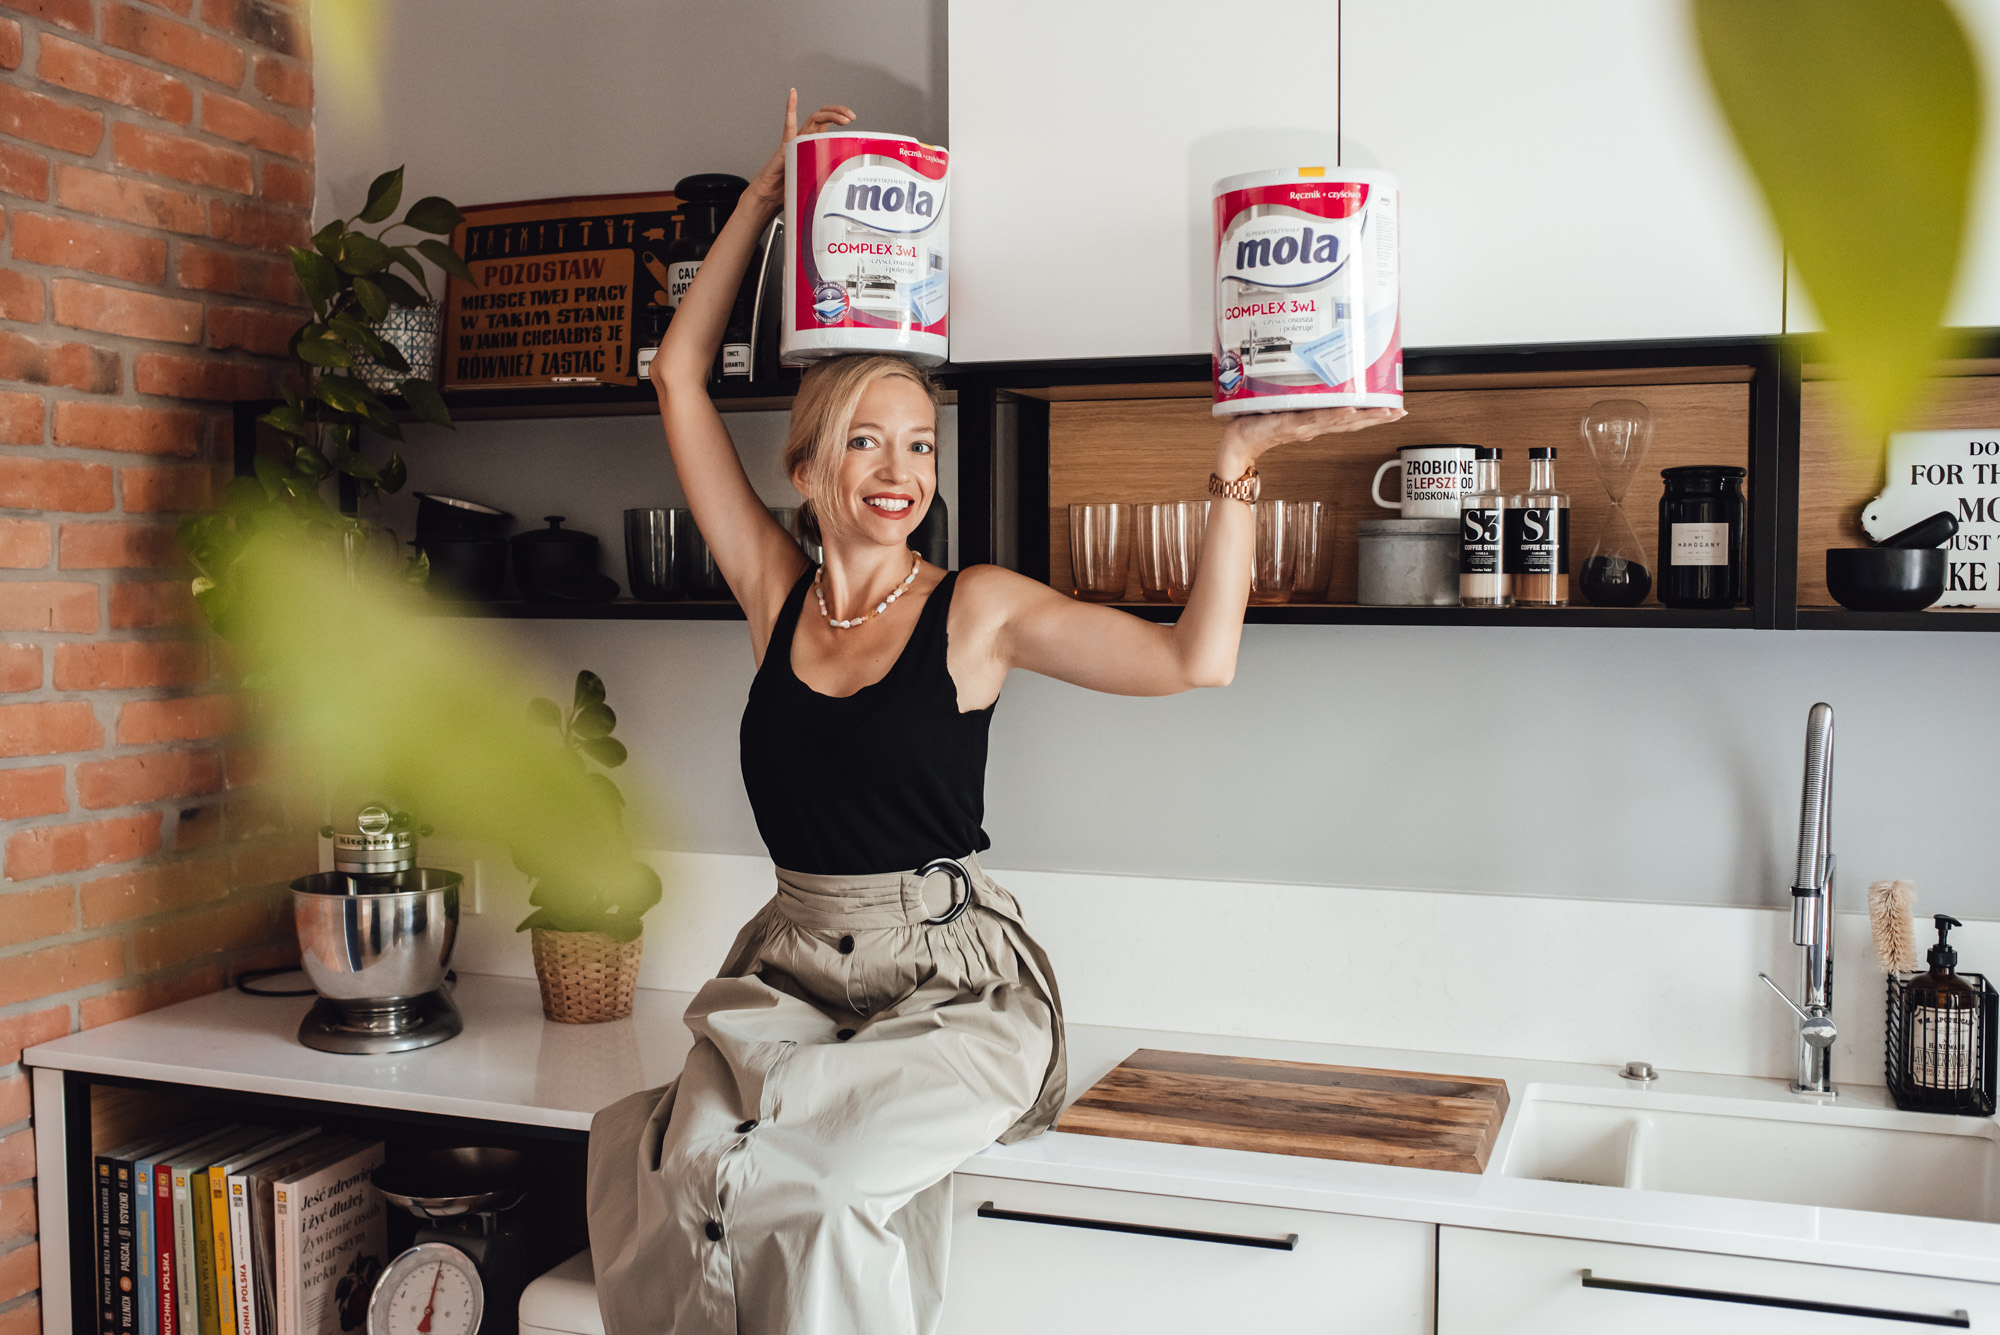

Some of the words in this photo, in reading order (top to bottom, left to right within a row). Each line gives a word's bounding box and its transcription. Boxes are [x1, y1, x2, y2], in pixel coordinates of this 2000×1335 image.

[899, 148, 922, 158] Ręcznik
[845, 181, 934, 218] mola
[1290, 190, 1321, 201] Ręcznik
[828, 242, 892, 256] COMPLEX
[896, 246, 917, 258] 3w1
[1236, 227, 1339, 270] mola
[484, 257, 606, 288] POZOSTAW
[461, 290, 527, 312] MIEJSCE
[529, 290, 568, 306] TWEJ
[574, 284, 628, 303] PRACY
[826, 291, 832, 300] 3
[460, 314, 480, 329] W
[485, 308, 550, 329] TAKIM
[556, 304, 626, 324] STANIE
[1225, 302, 1286, 320] COMPLEX
[1290, 300, 1316, 312] 3w1
[460, 334, 474, 350] W
[475, 331, 518, 348] JAKIM
[606, 324, 624, 342] JE
[1283, 325, 1314, 334] poleruje
[457, 352, 533, 380] RÓWNIEŻ
[541, 345, 605, 376] ZASTAĆ
[1406, 460, 1474, 475] ZROBIONE
[1911, 464, 1964, 486] FOR
[1414, 477, 1456, 489] LEPSZE
[1461, 477, 1473, 489] OD
[1464, 509, 1502, 542] S3
[1522, 509, 1555, 542] S1
[1946, 534, 1992, 550] JUST
[1945, 562, 1988, 591] KE
[340, 836, 409, 845] KitchenAid
[118, 1193, 129, 1225] OKRASA
[301, 1190, 326, 1211] Jeść
[302, 1218, 306, 1233] i
[308, 1208, 328, 1230] żyć
[302, 1217, 352, 1255] Żywienie
[354, 1202, 380, 1228] osób
[120, 1242, 131, 1272] PASCAL
[200, 1240, 208, 1265] DIETA
[303, 1261, 313, 1272] w
[314, 1231, 366, 1264] starszym
[162, 1252, 170, 1290] POLSKA
[202, 1268, 209, 1281] NA
[240, 1264, 248, 1302] POLSKA
[303, 1264, 338, 1290] wieku
[121, 1296, 132, 1327] KONTRA
[203, 1284, 212, 1318] WYNOS
